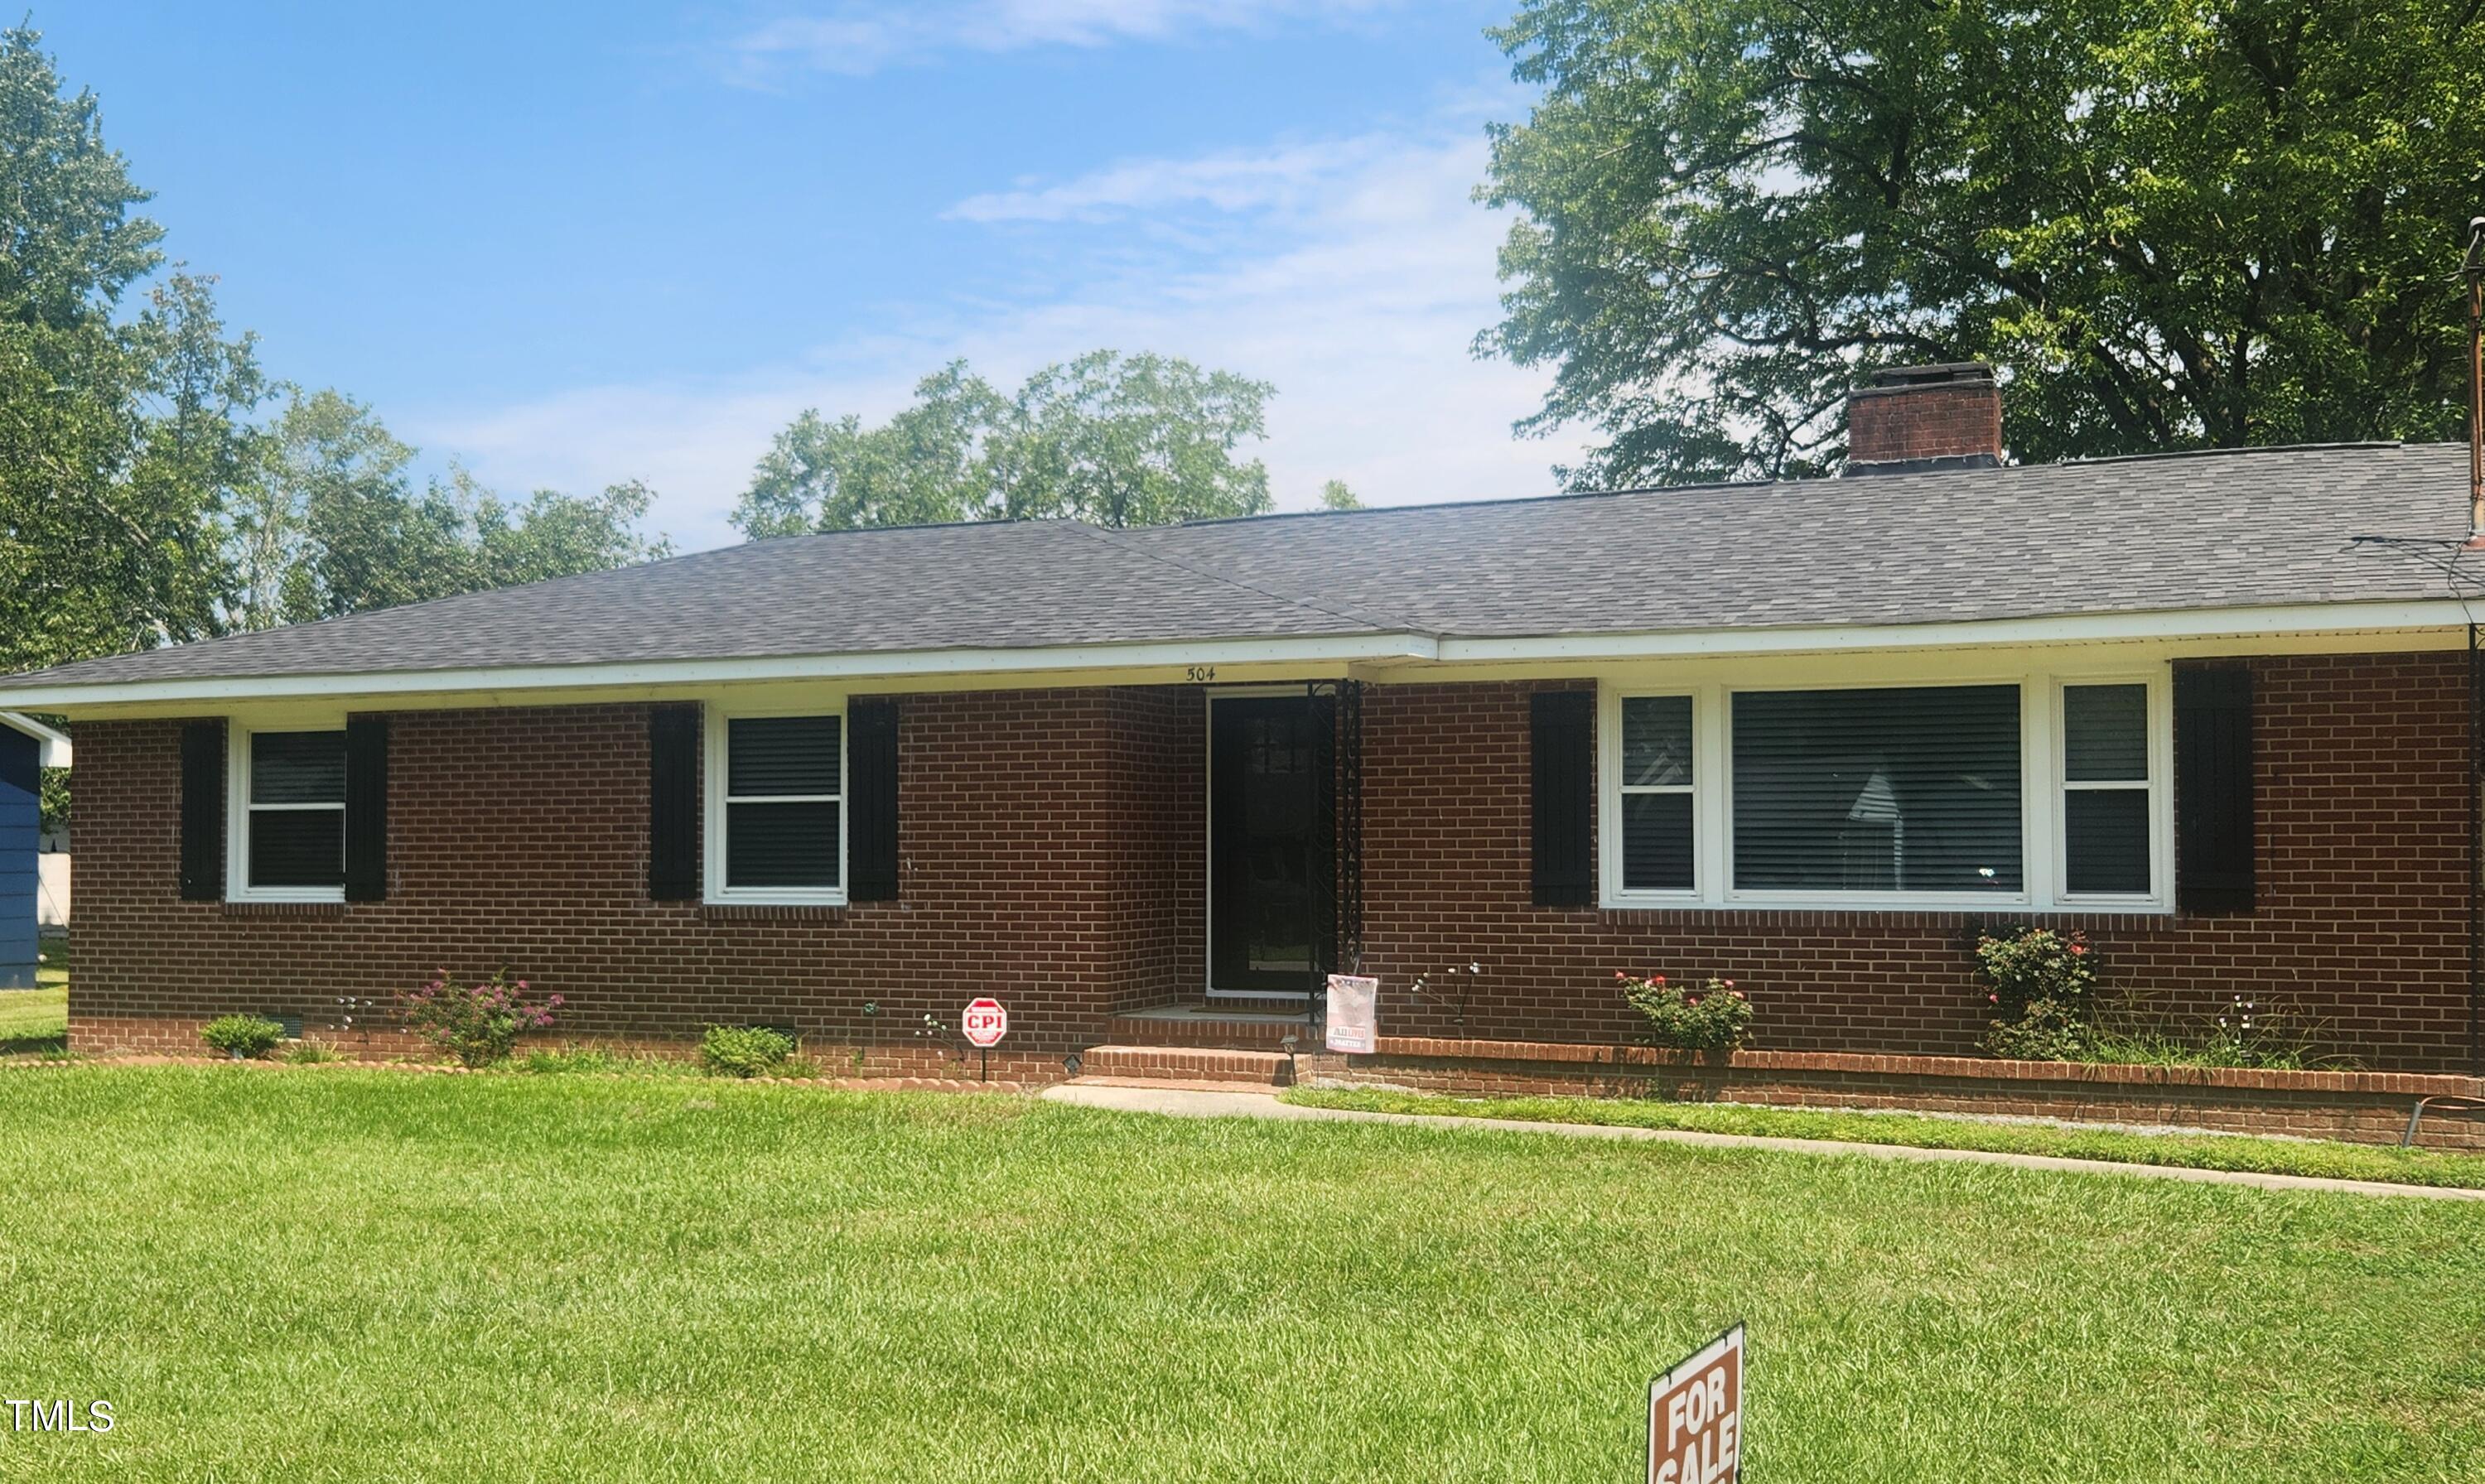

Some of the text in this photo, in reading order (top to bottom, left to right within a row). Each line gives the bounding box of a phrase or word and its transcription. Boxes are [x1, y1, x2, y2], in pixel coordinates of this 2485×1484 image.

[1186, 666, 1215, 682] 504
[967, 1015, 1002, 1029] CPI
[1667, 1366, 1726, 1453] FOR
